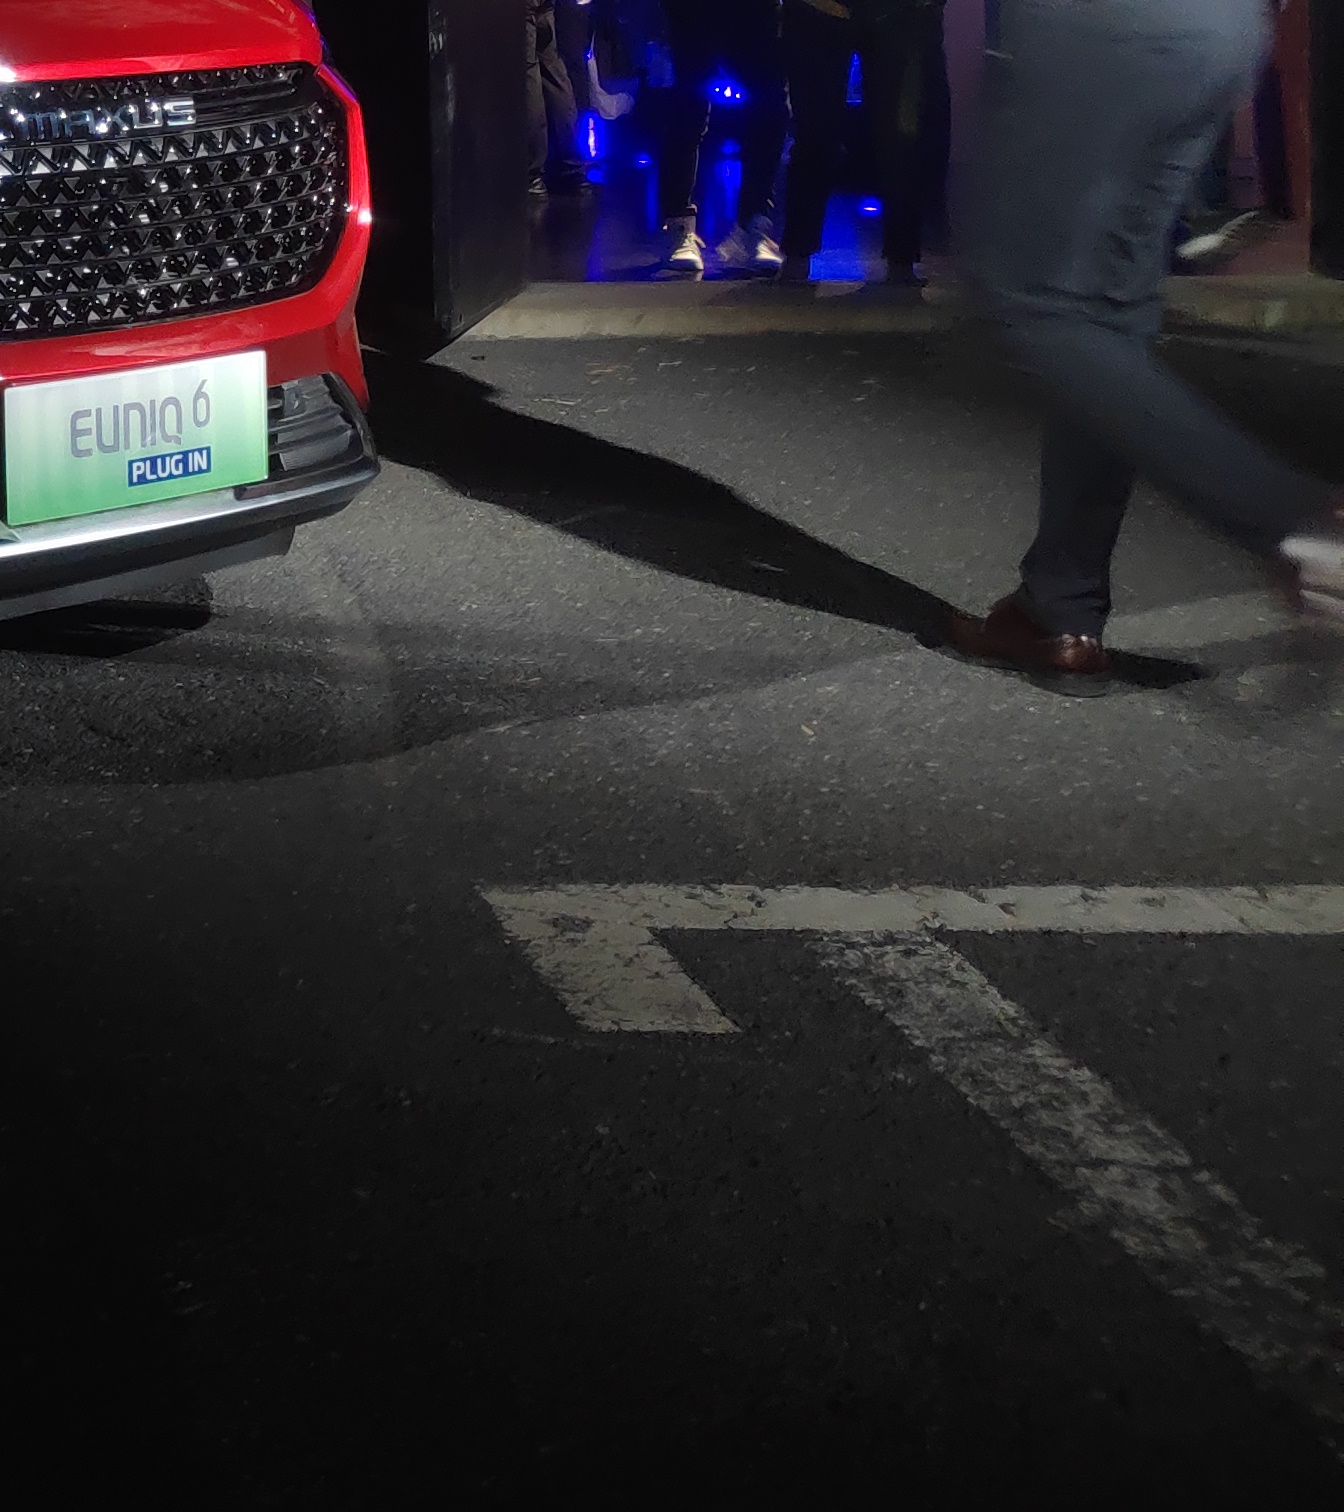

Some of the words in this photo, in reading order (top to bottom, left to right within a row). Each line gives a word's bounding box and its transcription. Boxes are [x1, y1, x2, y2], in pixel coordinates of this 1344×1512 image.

[192, 378, 210, 428] 6
[132, 459, 184, 483] PLUG
[188, 449, 208, 473] IN
